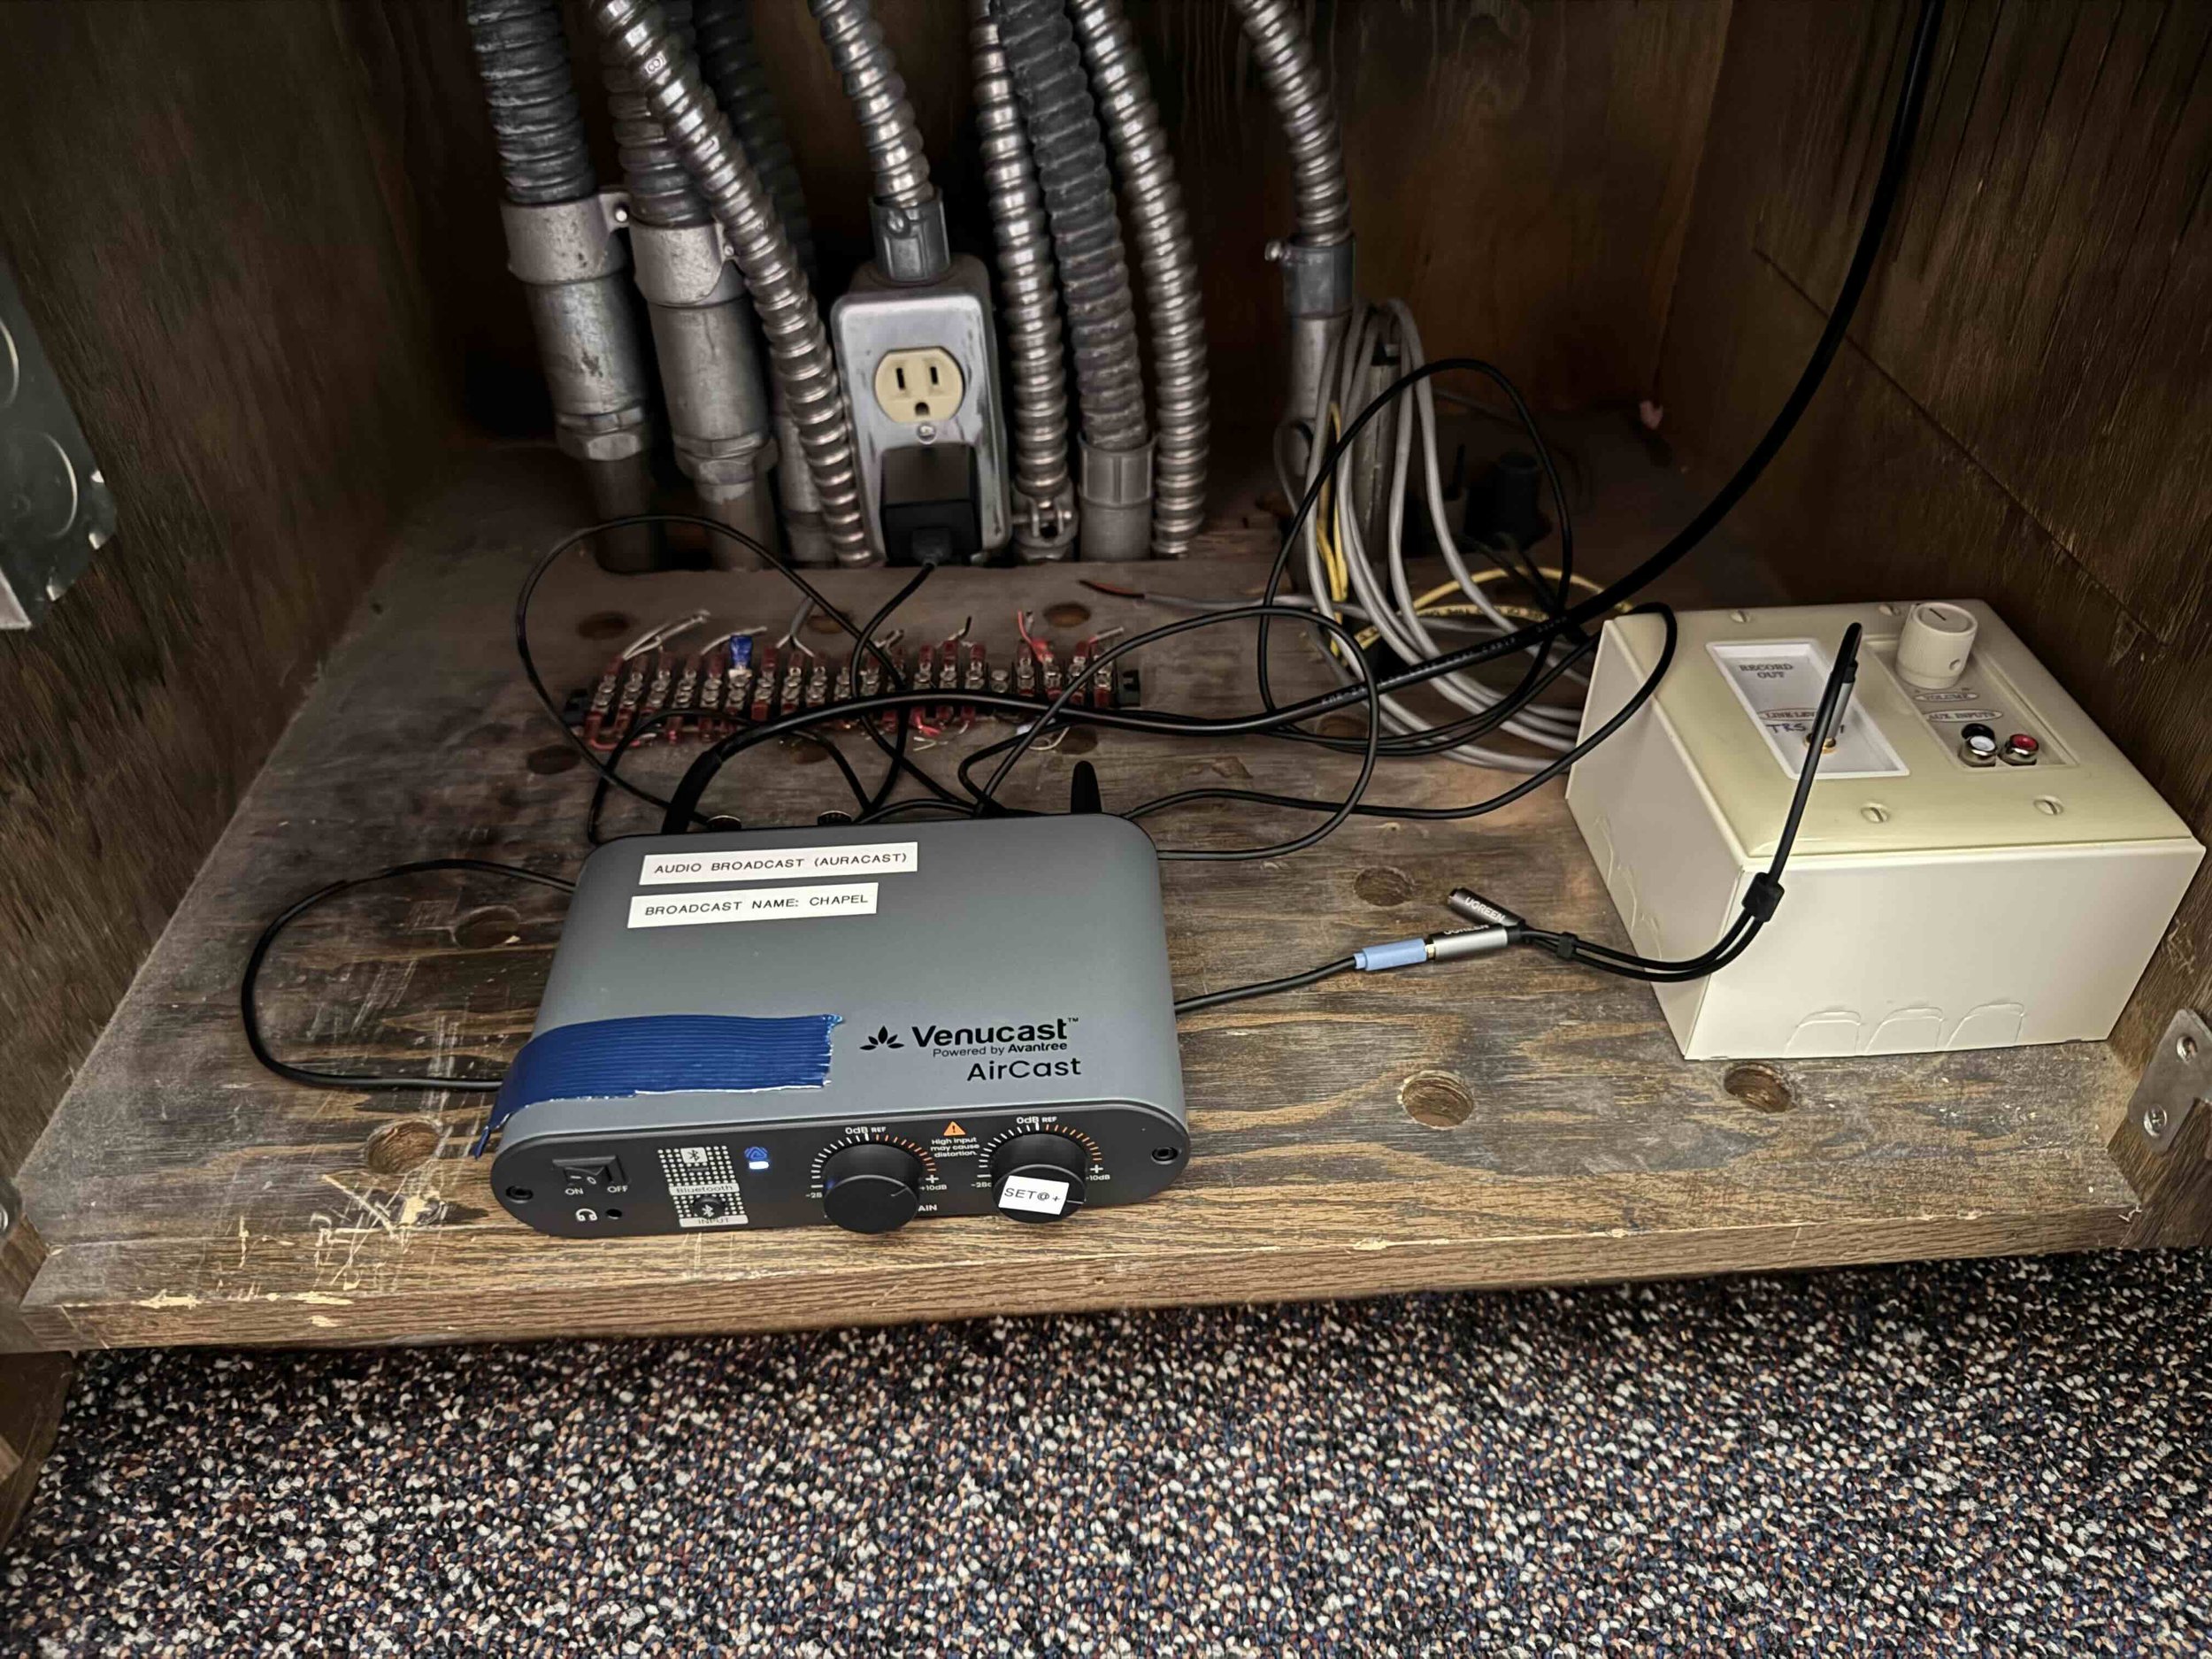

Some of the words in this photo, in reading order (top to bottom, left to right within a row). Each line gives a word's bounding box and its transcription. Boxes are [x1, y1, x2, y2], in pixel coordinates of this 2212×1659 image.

[1740, 663, 1793, 672] RECORD
[654, 862, 702, 874] AUDIO
[710, 857, 806, 872] BROADCAST
[814, 851, 908, 867] (AURACAST)
[645, 901, 743, 917] BROADCAST
[751, 897, 800, 910] NAME:
[809, 894, 869, 907] CHAPEL
[1464, 895, 1505, 924] UGREEN
[933, 1046, 987, 1058] Powered
[990, 1045, 1005, 1056] by
[1008, 1041, 1068, 1054] Avantree
[966, 1057, 1082, 1082] AirCast
[1016, 1116, 1040, 1125] 0dB
[607, 1185, 629, 1194] OFF
[676, 1185, 733, 1194] Bluetooth
[918, 1203, 938, 1212] AIN
